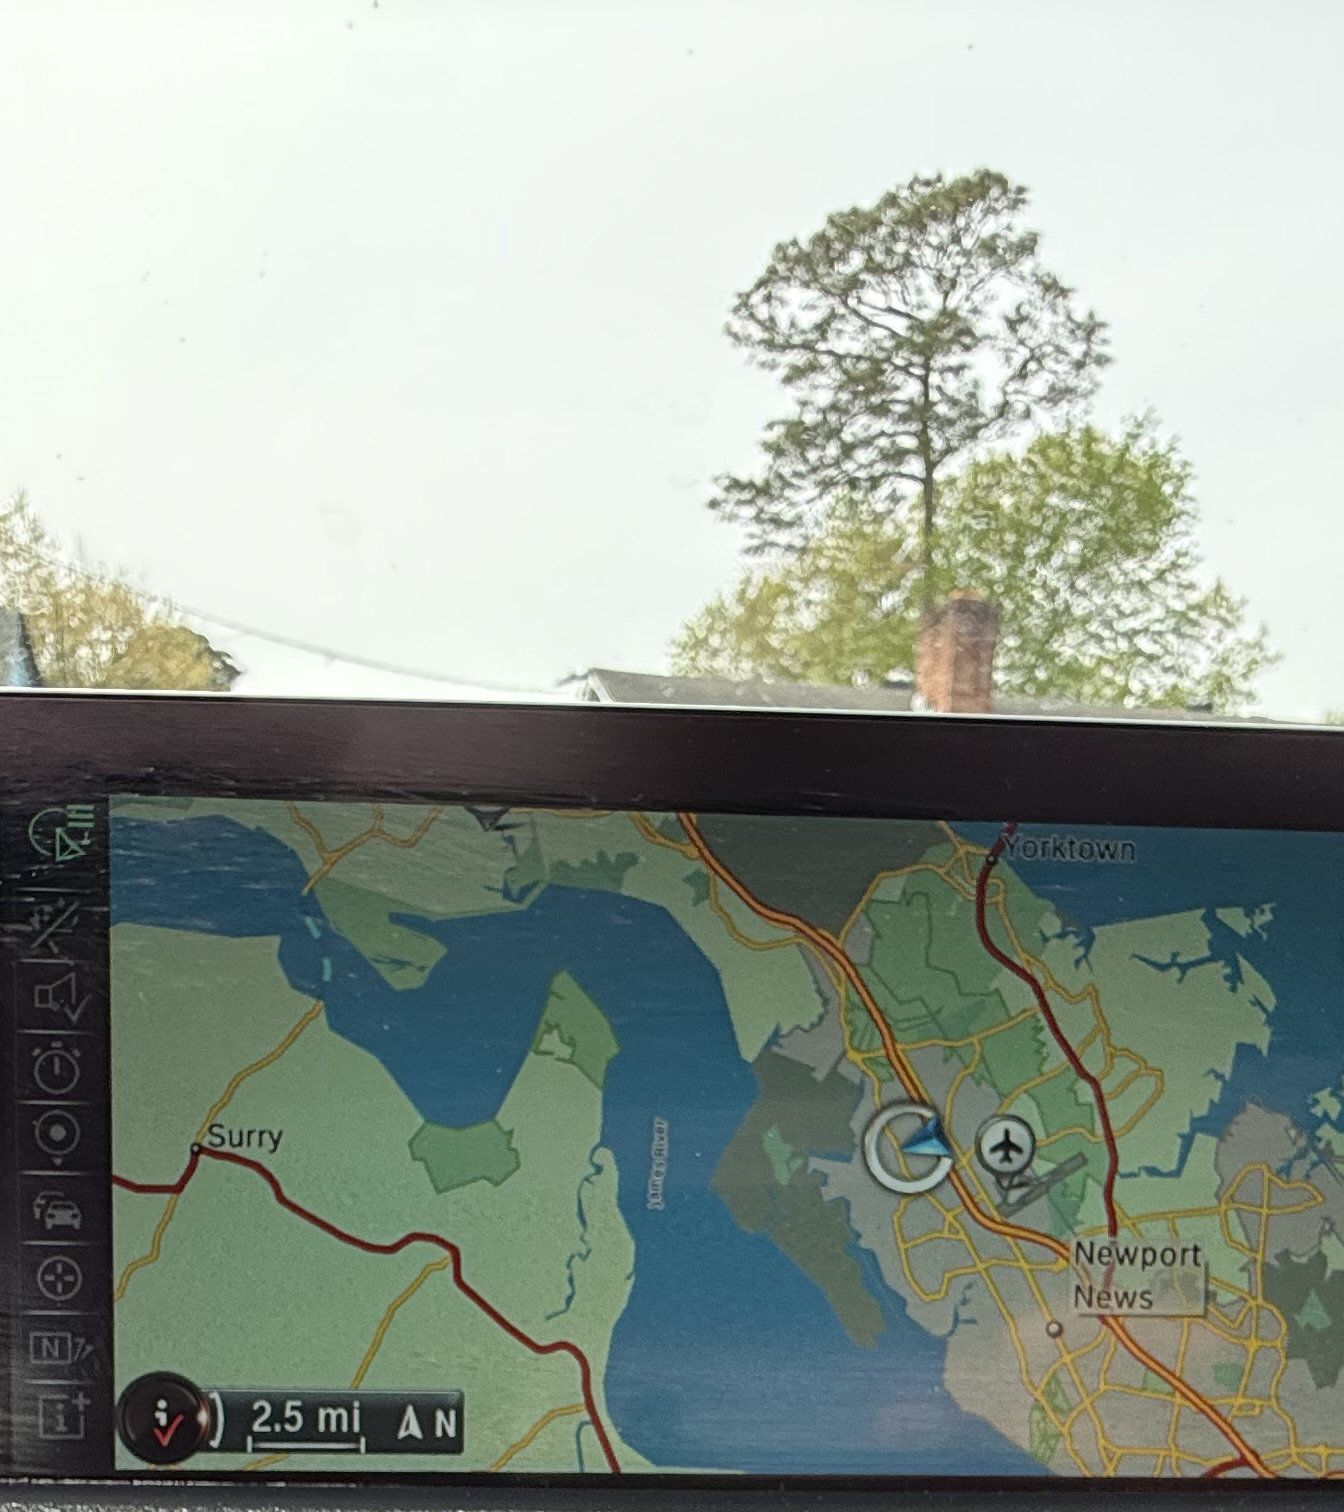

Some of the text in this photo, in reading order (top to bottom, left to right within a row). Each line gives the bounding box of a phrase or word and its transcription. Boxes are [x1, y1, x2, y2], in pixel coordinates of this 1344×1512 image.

[1006, 832, 1136, 862] Yorktown
[208, 1123, 283, 1154] Surry
[1074, 1240, 1202, 1272] Newport
[1074, 1284, 1154, 1310] News
[252, 1400, 361, 1434] 2.5 mi
[435, 1409, 456, 1438] N
